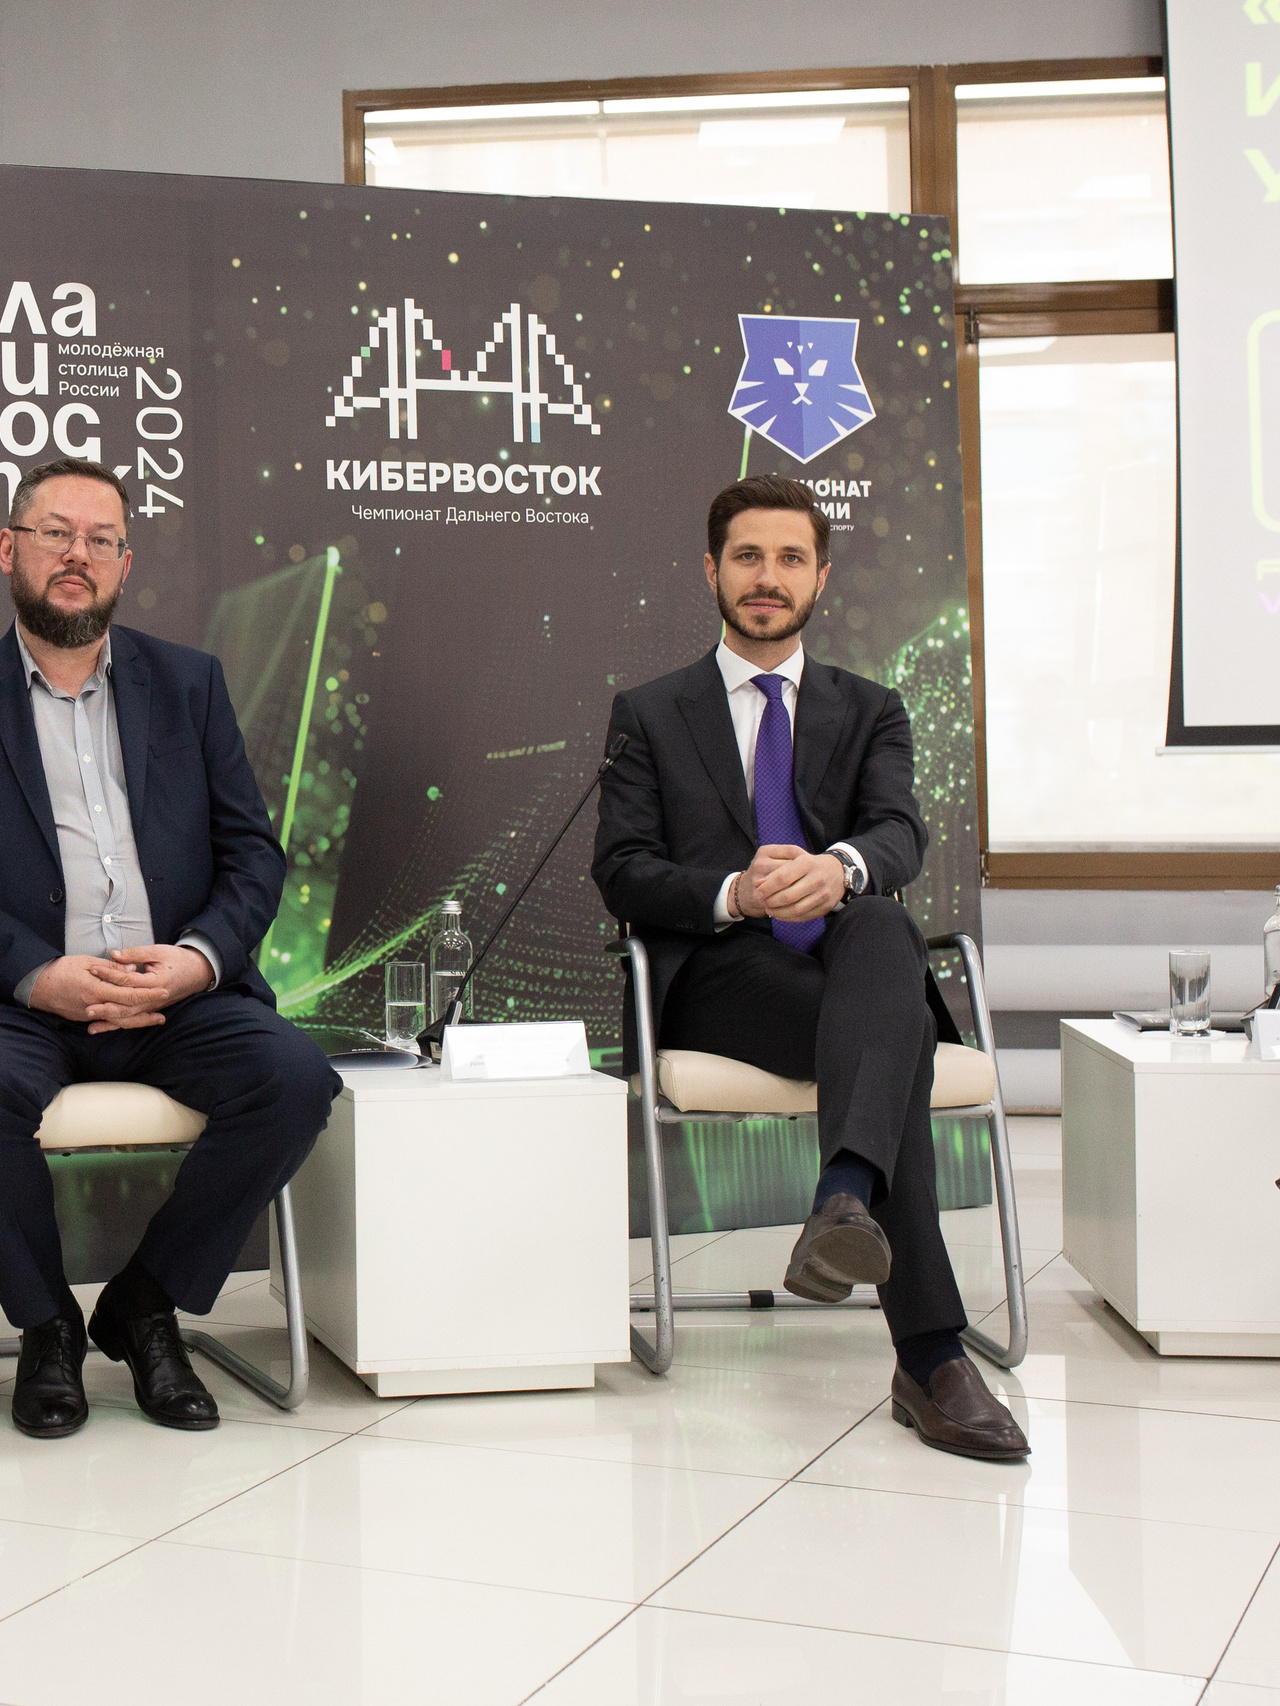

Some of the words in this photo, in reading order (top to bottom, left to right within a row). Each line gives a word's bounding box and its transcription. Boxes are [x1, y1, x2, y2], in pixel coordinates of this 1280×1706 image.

[58, 342, 164, 358] молодёжная
[58, 363, 128, 379] столица
[58, 381, 120, 397] России
[135, 366, 184, 518] 2024
[326, 459, 602, 496] КИБЕРВОСТОК
[351, 504, 441, 521] Чемпионат
[445, 506, 521, 524] Дальнего
[525, 508, 589, 524] Востока
